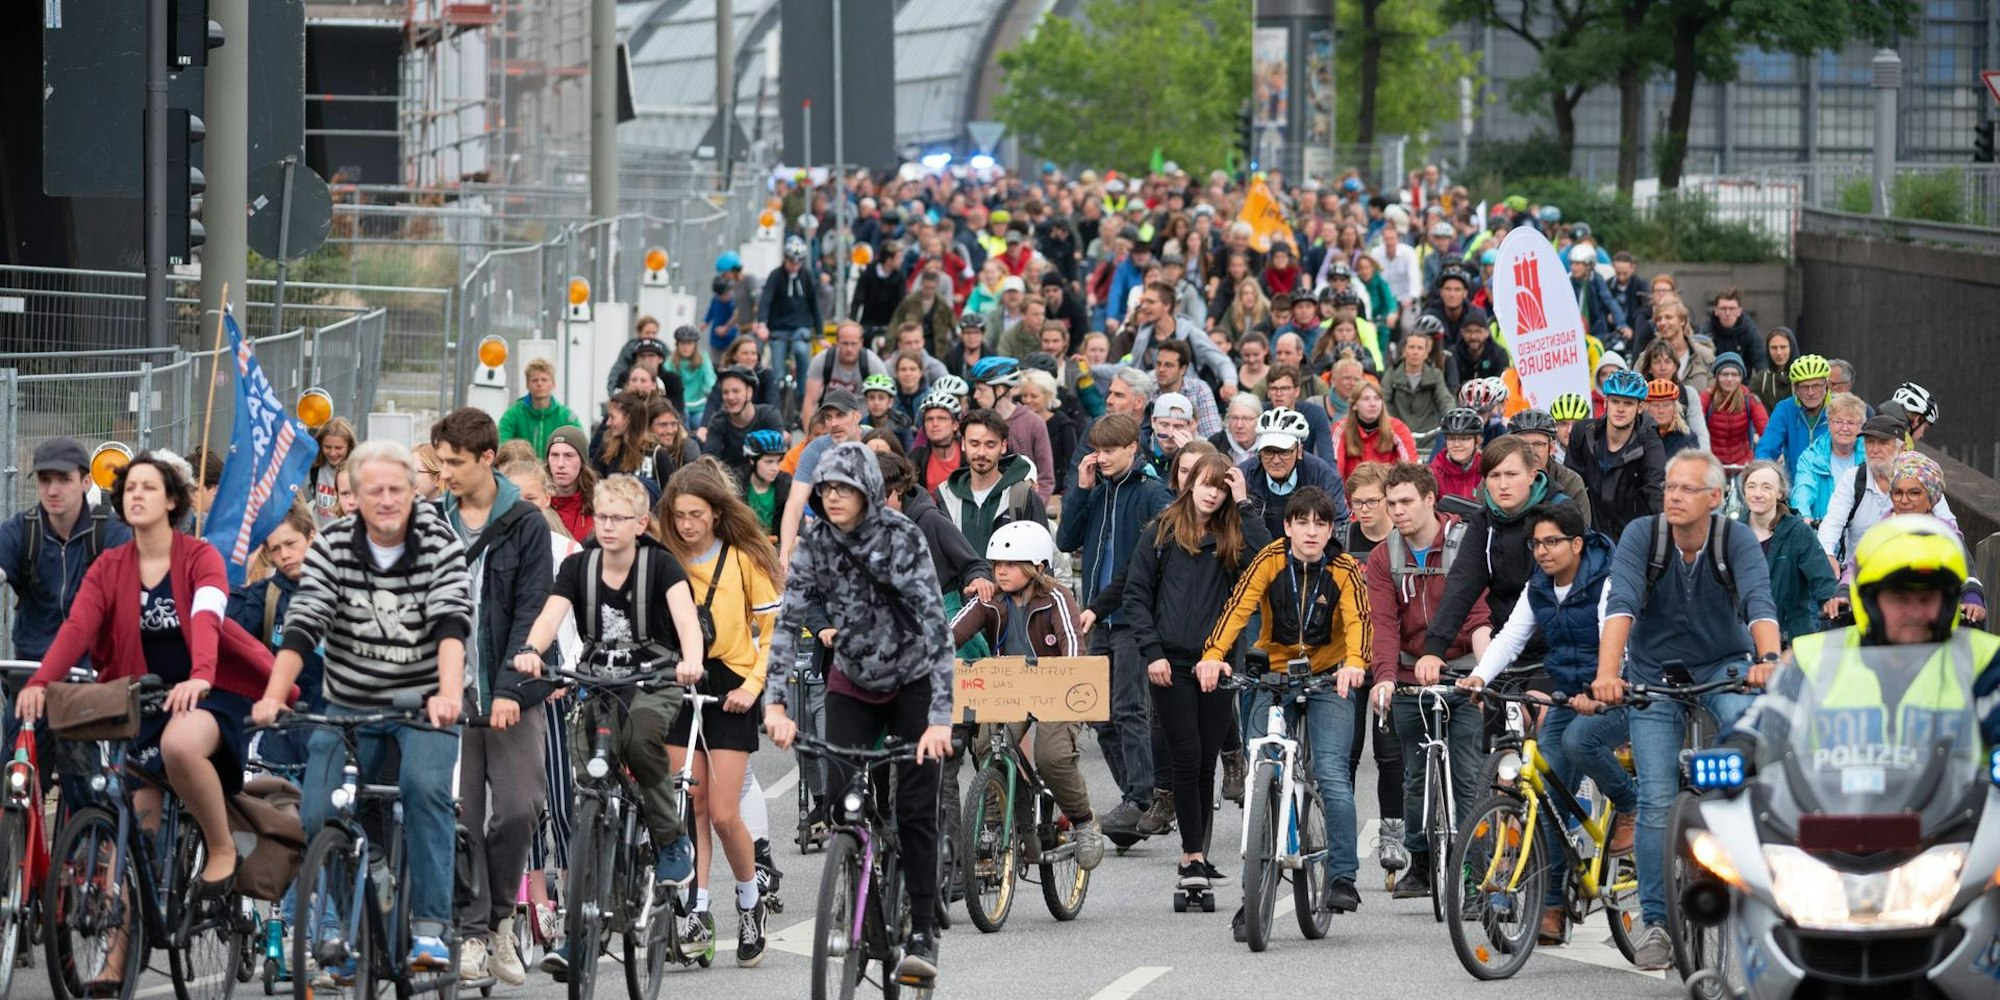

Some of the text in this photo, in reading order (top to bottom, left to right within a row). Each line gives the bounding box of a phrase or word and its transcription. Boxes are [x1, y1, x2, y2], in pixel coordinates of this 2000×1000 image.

[247, 364, 268, 420] ATZ
[955, 666, 985, 675] OMMT
[991, 666, 1013, 675] DIE
[961, 678, 1014, 691] IHR WAS
[968, 695, 1056, 707] MIT SINN TUT
